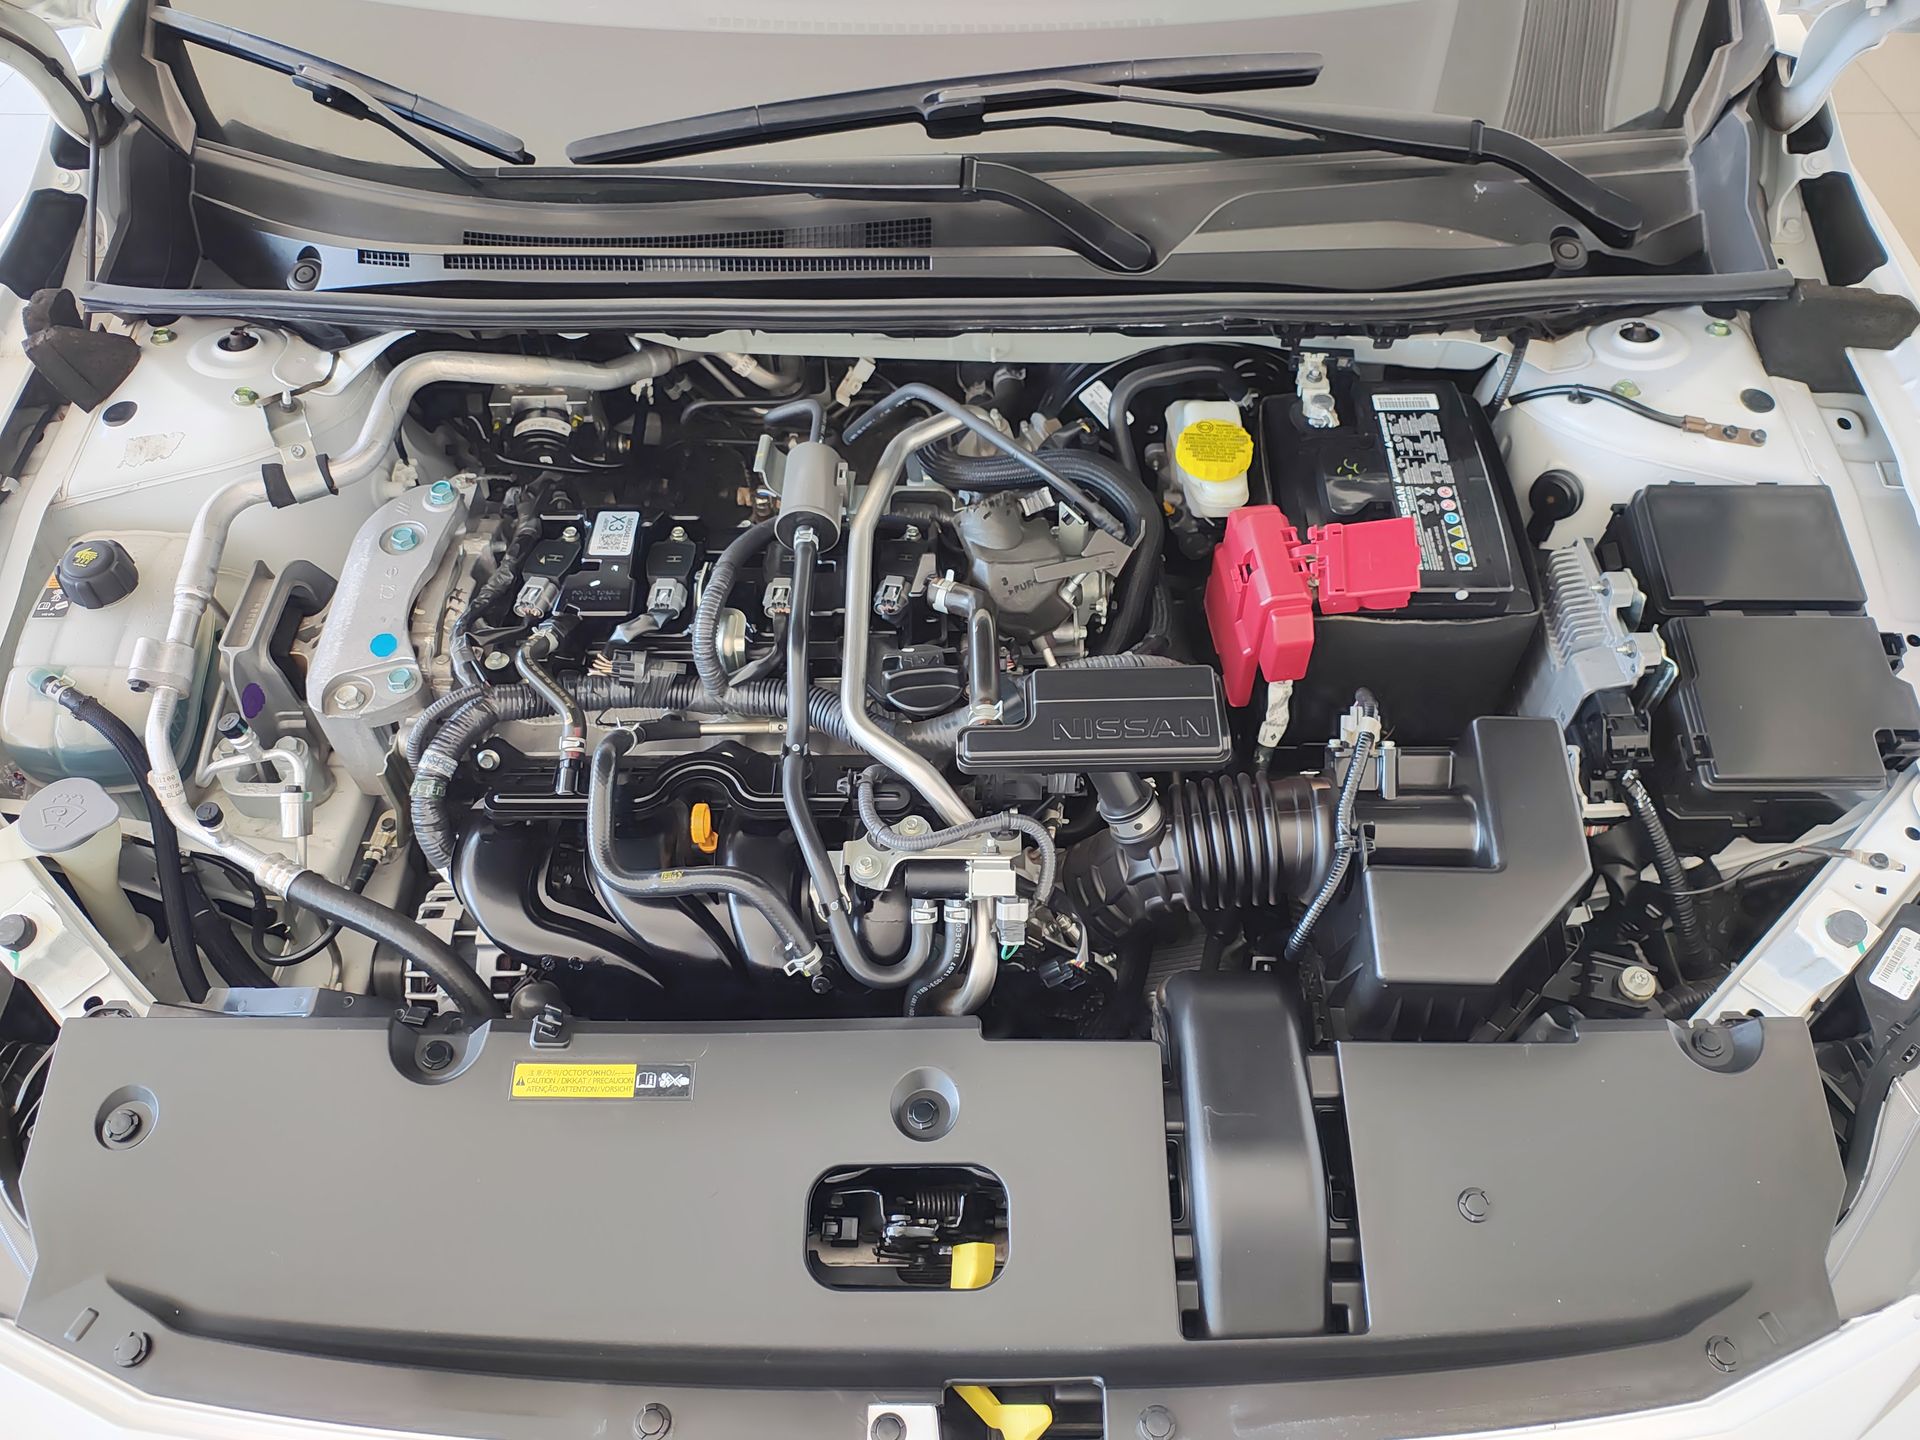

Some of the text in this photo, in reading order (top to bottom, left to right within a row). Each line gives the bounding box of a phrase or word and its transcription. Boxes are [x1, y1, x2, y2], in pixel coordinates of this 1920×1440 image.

[1395, 485, 1412, 518] ISSAN
[608, 515, 627, 532] X3
[1052, 715, 1211, 741] NISSAN
[526, 1077, 556, 1085] CAUTION
